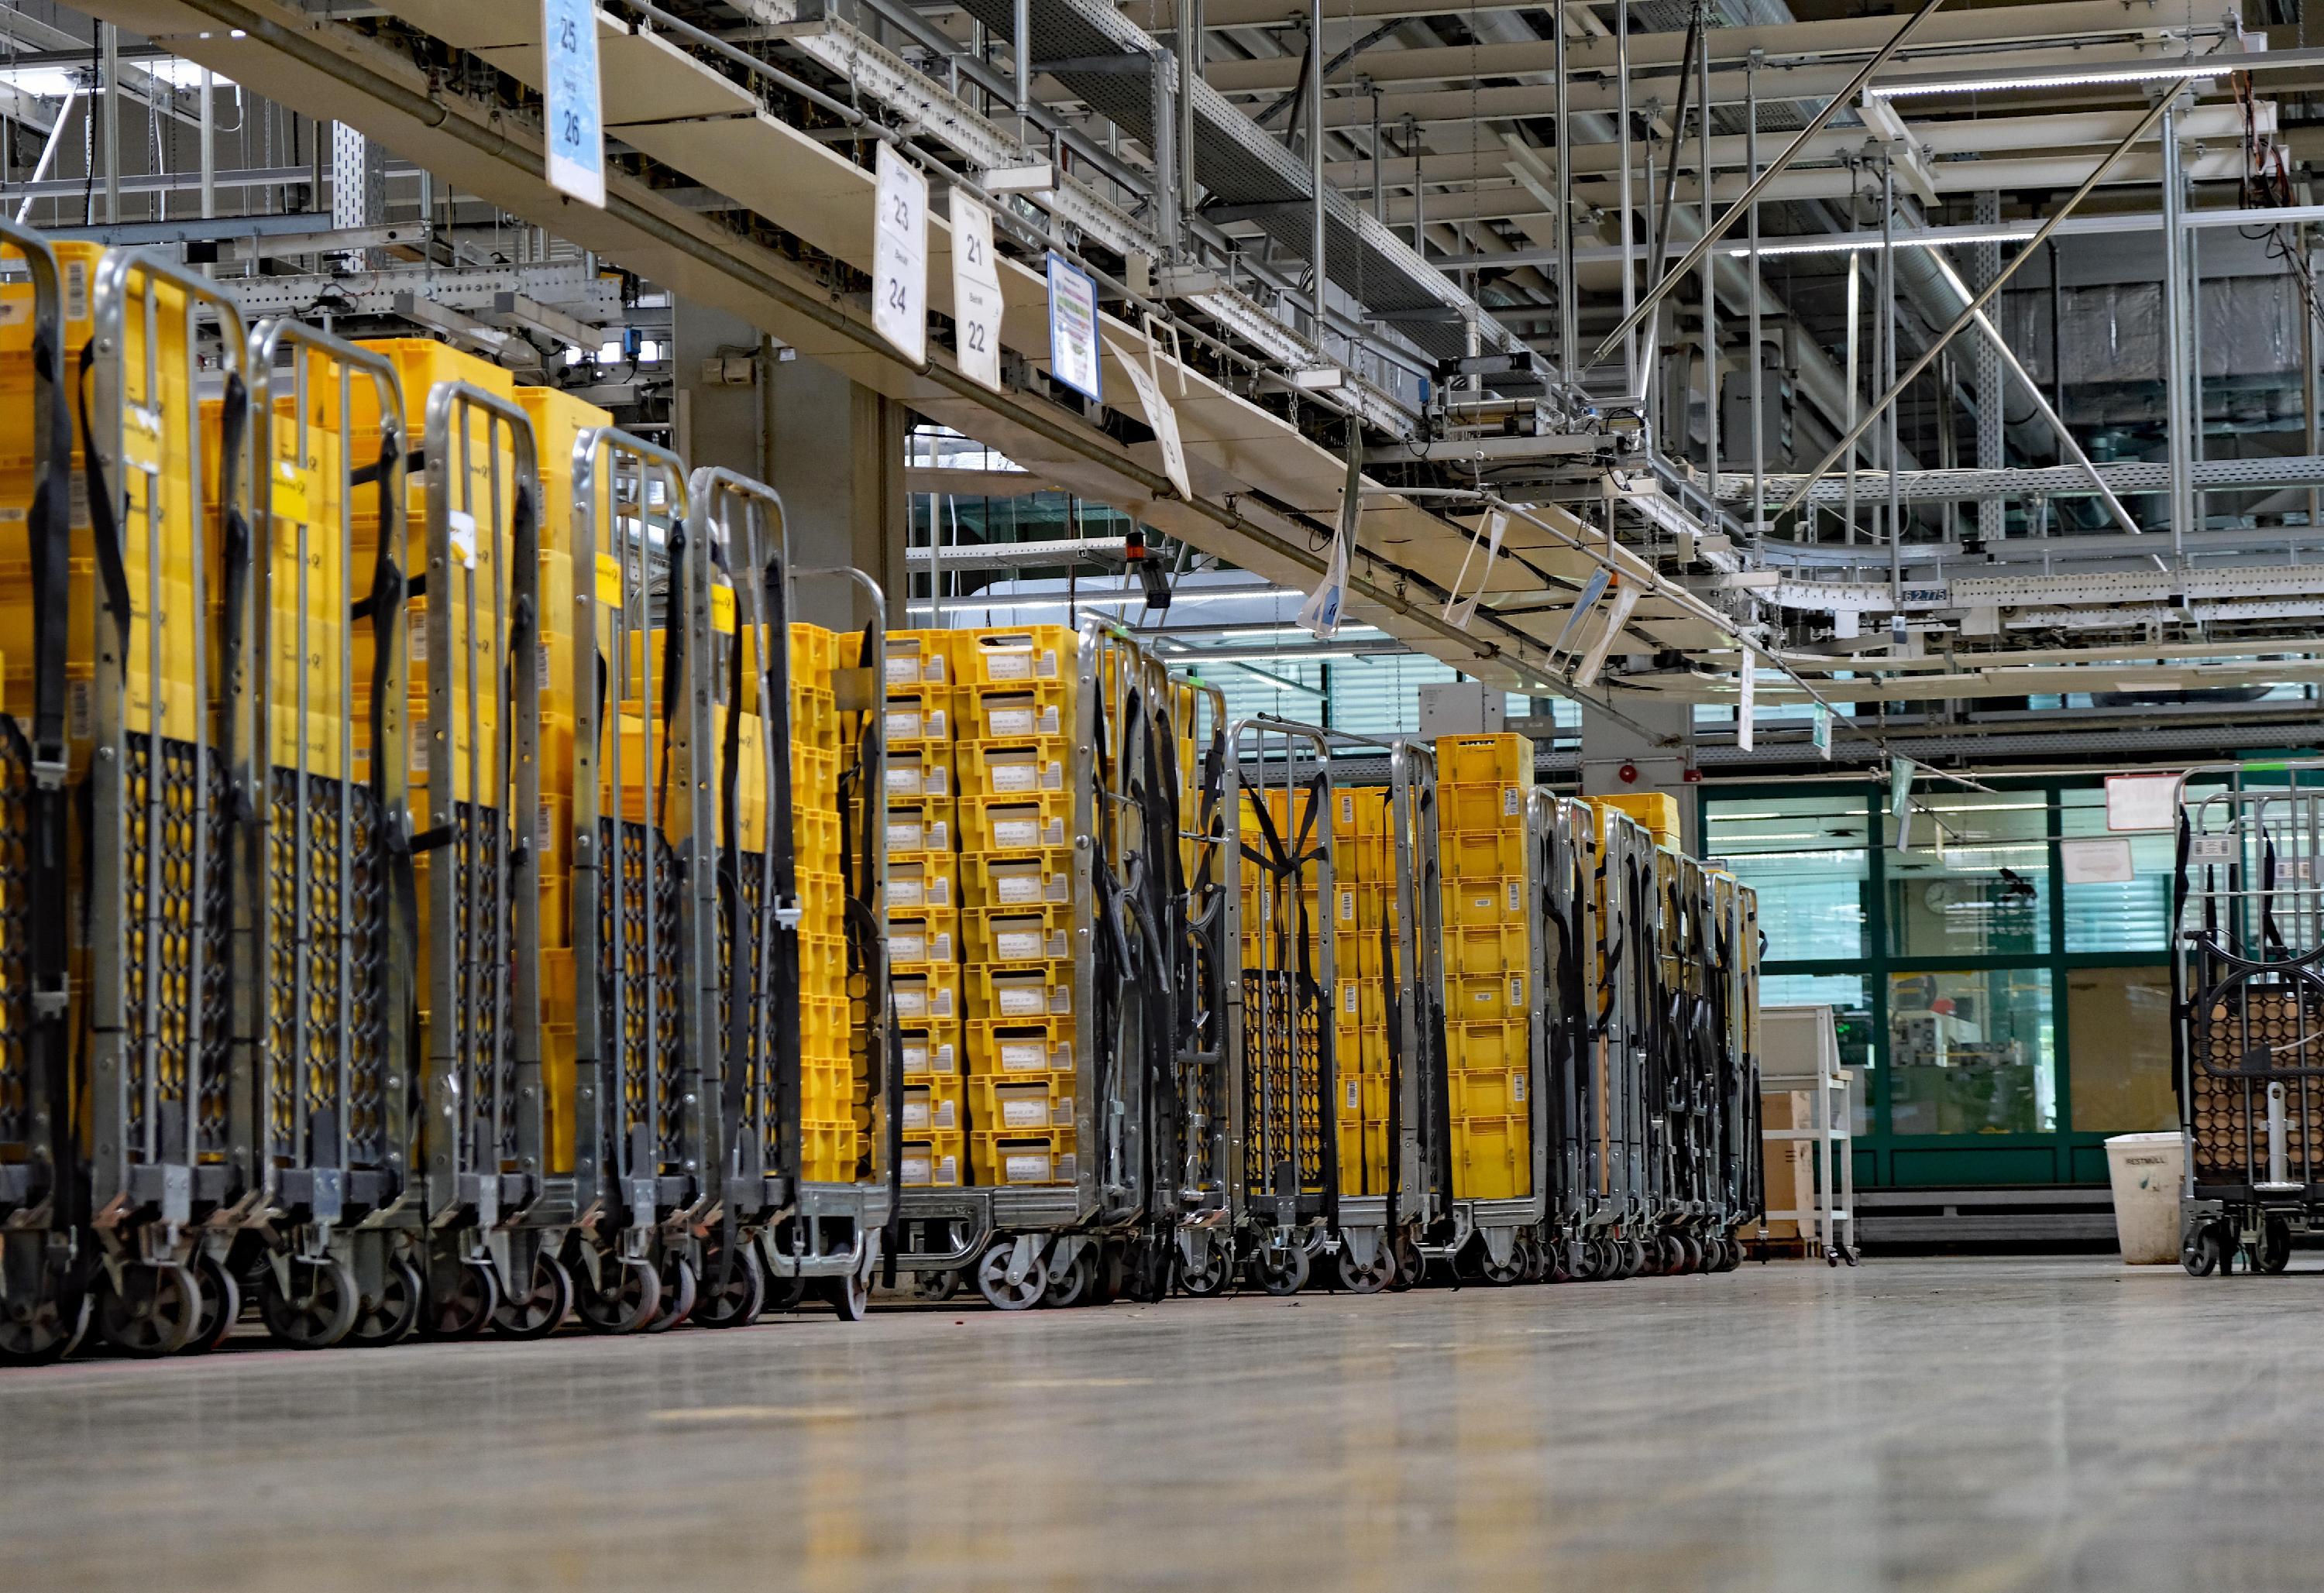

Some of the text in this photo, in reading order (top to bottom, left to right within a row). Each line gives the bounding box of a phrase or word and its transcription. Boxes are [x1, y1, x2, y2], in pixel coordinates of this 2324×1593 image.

[561, 18, 576, 53] 25
[564, 110, 579, 146] 26
[893, 194, 909, 231] 23
[967, 233, 982, 266] 21
[889, 277, 906, 315] 24
[968, 320, 985, 353] 22
